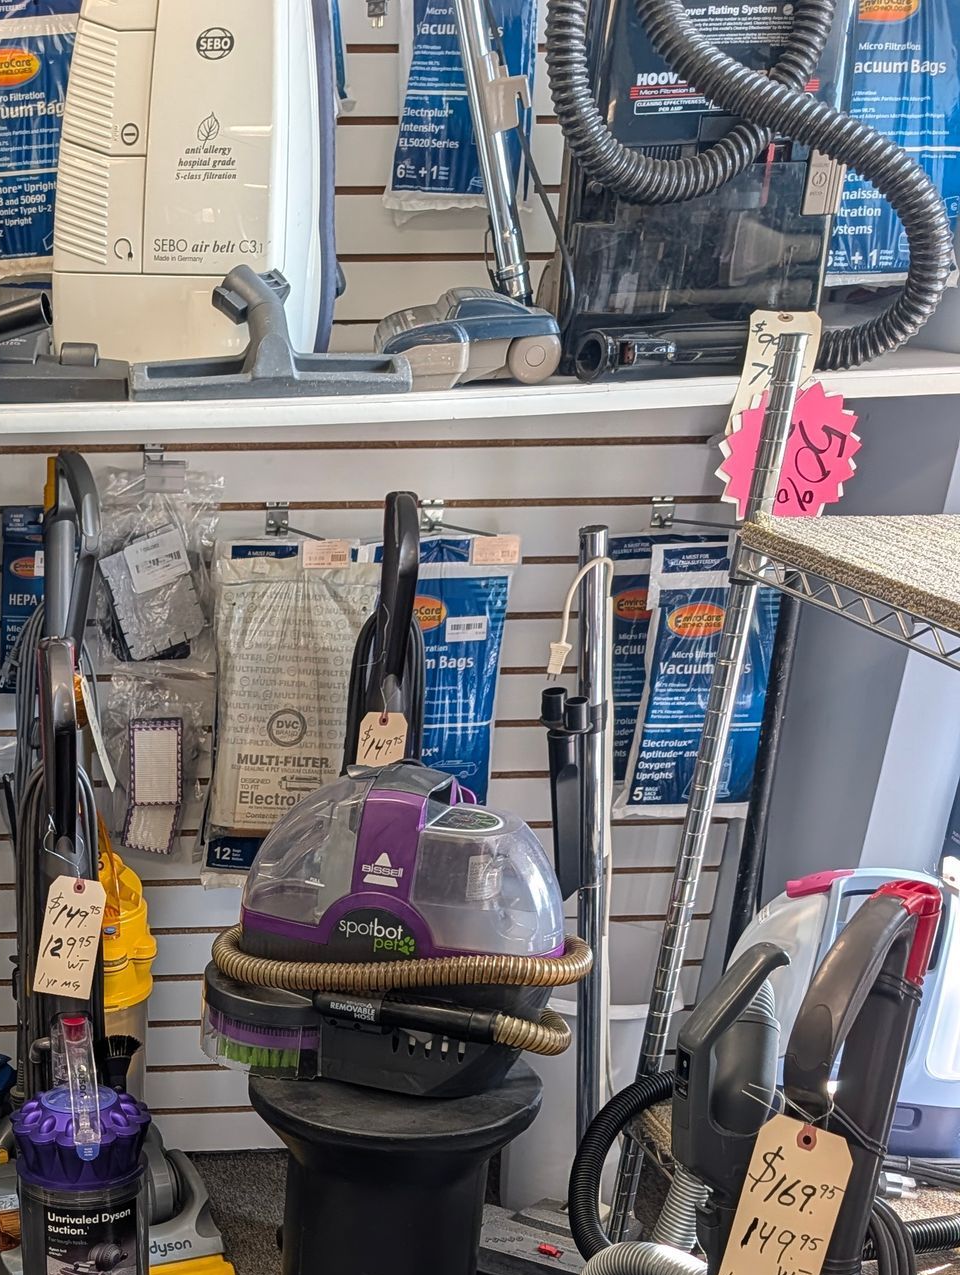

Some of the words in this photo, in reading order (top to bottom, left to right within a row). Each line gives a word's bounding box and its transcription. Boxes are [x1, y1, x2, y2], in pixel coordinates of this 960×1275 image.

[426, 7, 448, 16] Micro
[708, 5, 740, 16] Rating
[742, 5, 778, 15] System
[199, 37, 231, 51] SEBO
[859, 42, 883, 51] Micro
[884, 41, 921, 51] Filtration
[854, 60, 908, 74] acuum
[910, 59, 947, 75] Bags
[9, 91, 45, 101] Filtration
[36, 101, 65, 117] Bag
[402, 107, 453, 118] Electrolux
[400, 123, 444, 134] Intensity
[398, 138, 430, 148] EL5020
[431, 138, 460, 149] Series
[185, 146, 201, 155] anti
[203, 145, 232, 156] allergy
[178, 158, 210, 169] hospital
[212, 158, 236, 168] grade
[202, 171, 237, 182] filtration
[396, 164, 405, 179] 6
[23, 181, 57, 193] Upright
[5, 197, 19, 206] and
[20, 194, 46, 205] 50690
[19, 206, 37, 216] Type
[38, 205, 52, 213] U-2
[4, 217, 32, 226] Upright
[832, 225, 872, 236] ystems
[153, 239, 188, 253] SEBO
[191, 242, 210, 254] air
[212, 241, 236, 254] belt
[177, 255, 203, 263] Germany
[9, 594, 37, 605] HEPA
[440, 656, 474, 669] Bags
[660, 662, 714, 675] Vacuum
[276, 721, 299, 729] DVC
[640, 751, 678, 759] Aptitude
[638, 762, 671, 770] Oxygen
[636, 772, 673, 781] Uprights
[632, 787, 643, 800] 5
[214, 847, 230, 860] 12
[338, 917, 403, 940] spotbot
[374, 937, 399, 952] pet
[68, 959, 89, 971] WT
[46, 979, 57, 988] yr
[330, 1001, 375, 1015] REMOVABLE
[354, 1010, 375, 1022] HOSE
[48, 1211, 99, 1225] Unrivaled
[101, 1208, 131, 1223] Dyson
[47, 1225, 88, 1236] suction.
[149, 1237, 192, 1257] dyson
